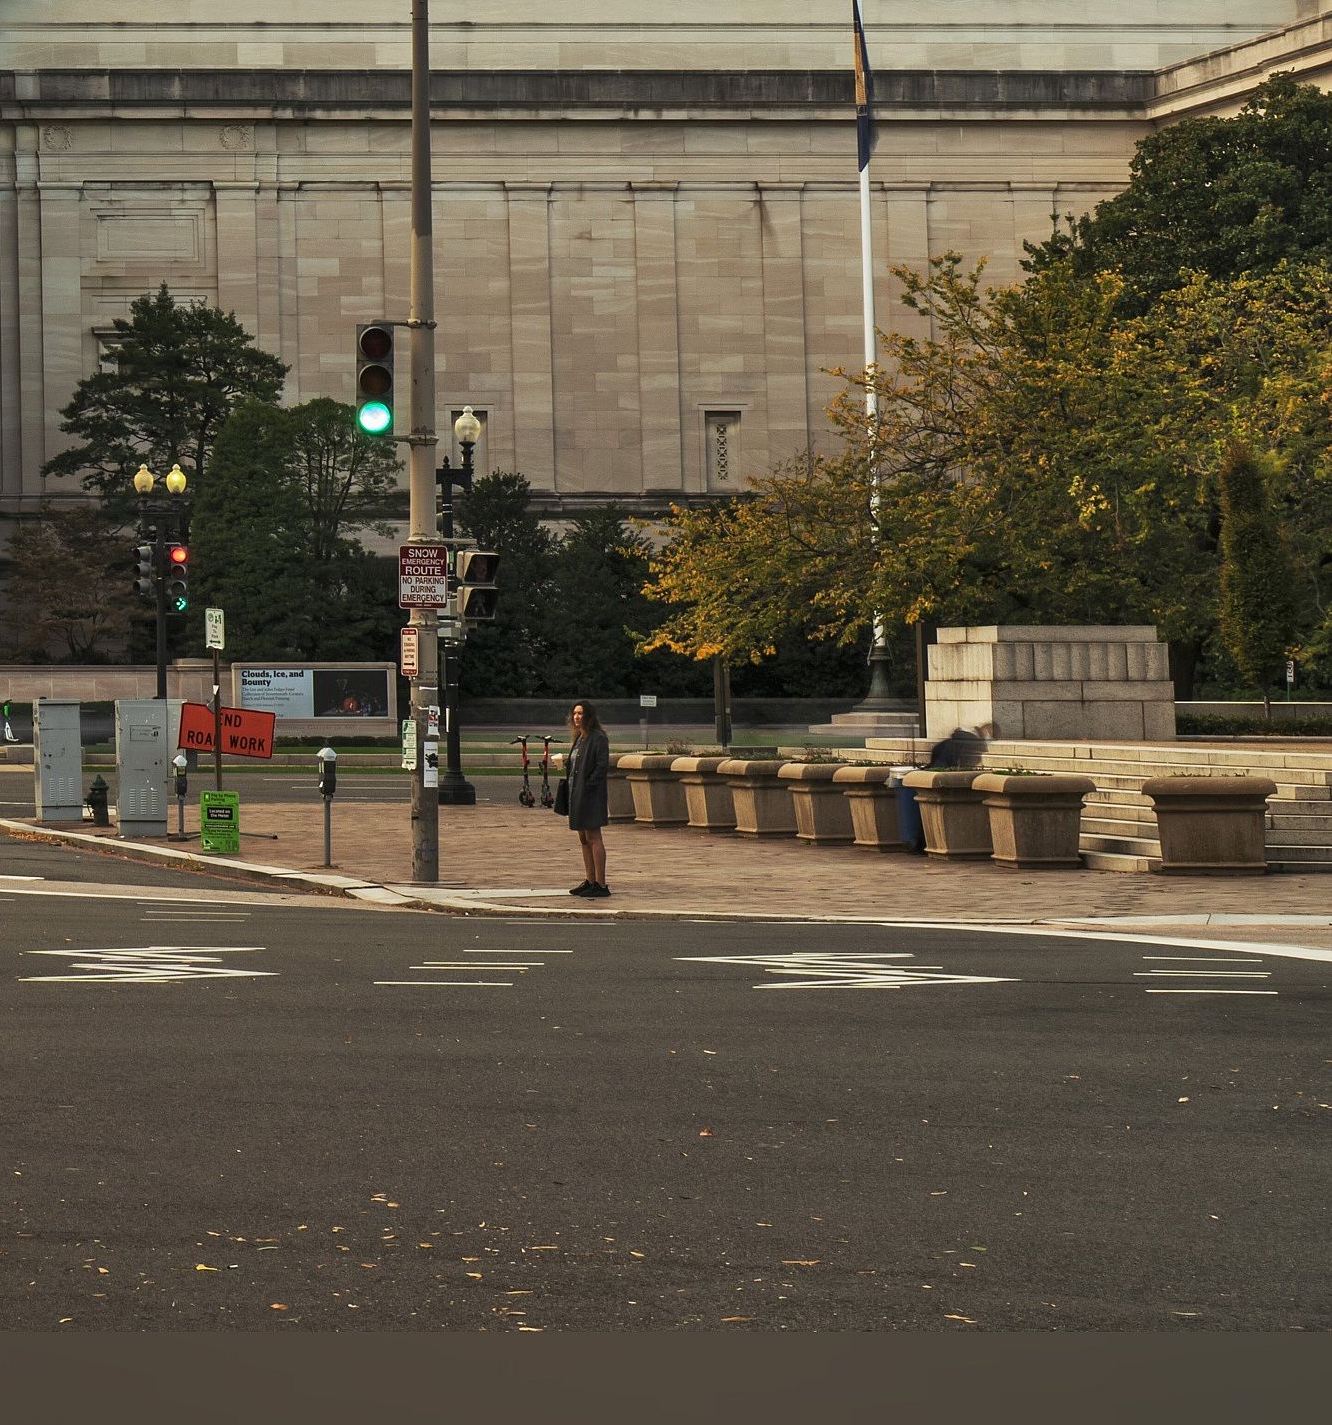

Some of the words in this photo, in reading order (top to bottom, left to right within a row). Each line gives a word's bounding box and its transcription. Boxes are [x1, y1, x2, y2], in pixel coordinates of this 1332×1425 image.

[408, 548, 438, 558] SNOW
[405, 566, 442, 575] ROUTE
[402, 576, 412, 585] NO
[415, 576, 445, 585] PARKING
[410, 585, 436, 593] DURING
[402, 594, 444, 602] EMERGENCY
[241, 670, 272, 679] Clouds,
[273, 670, 288, 679] Ice,
[289, 670, 304, 678] and
[241, 679, 271, 687] Bounty
[187, 730, 216, 746] ROA
[230, 735, 265, 752] WORK
